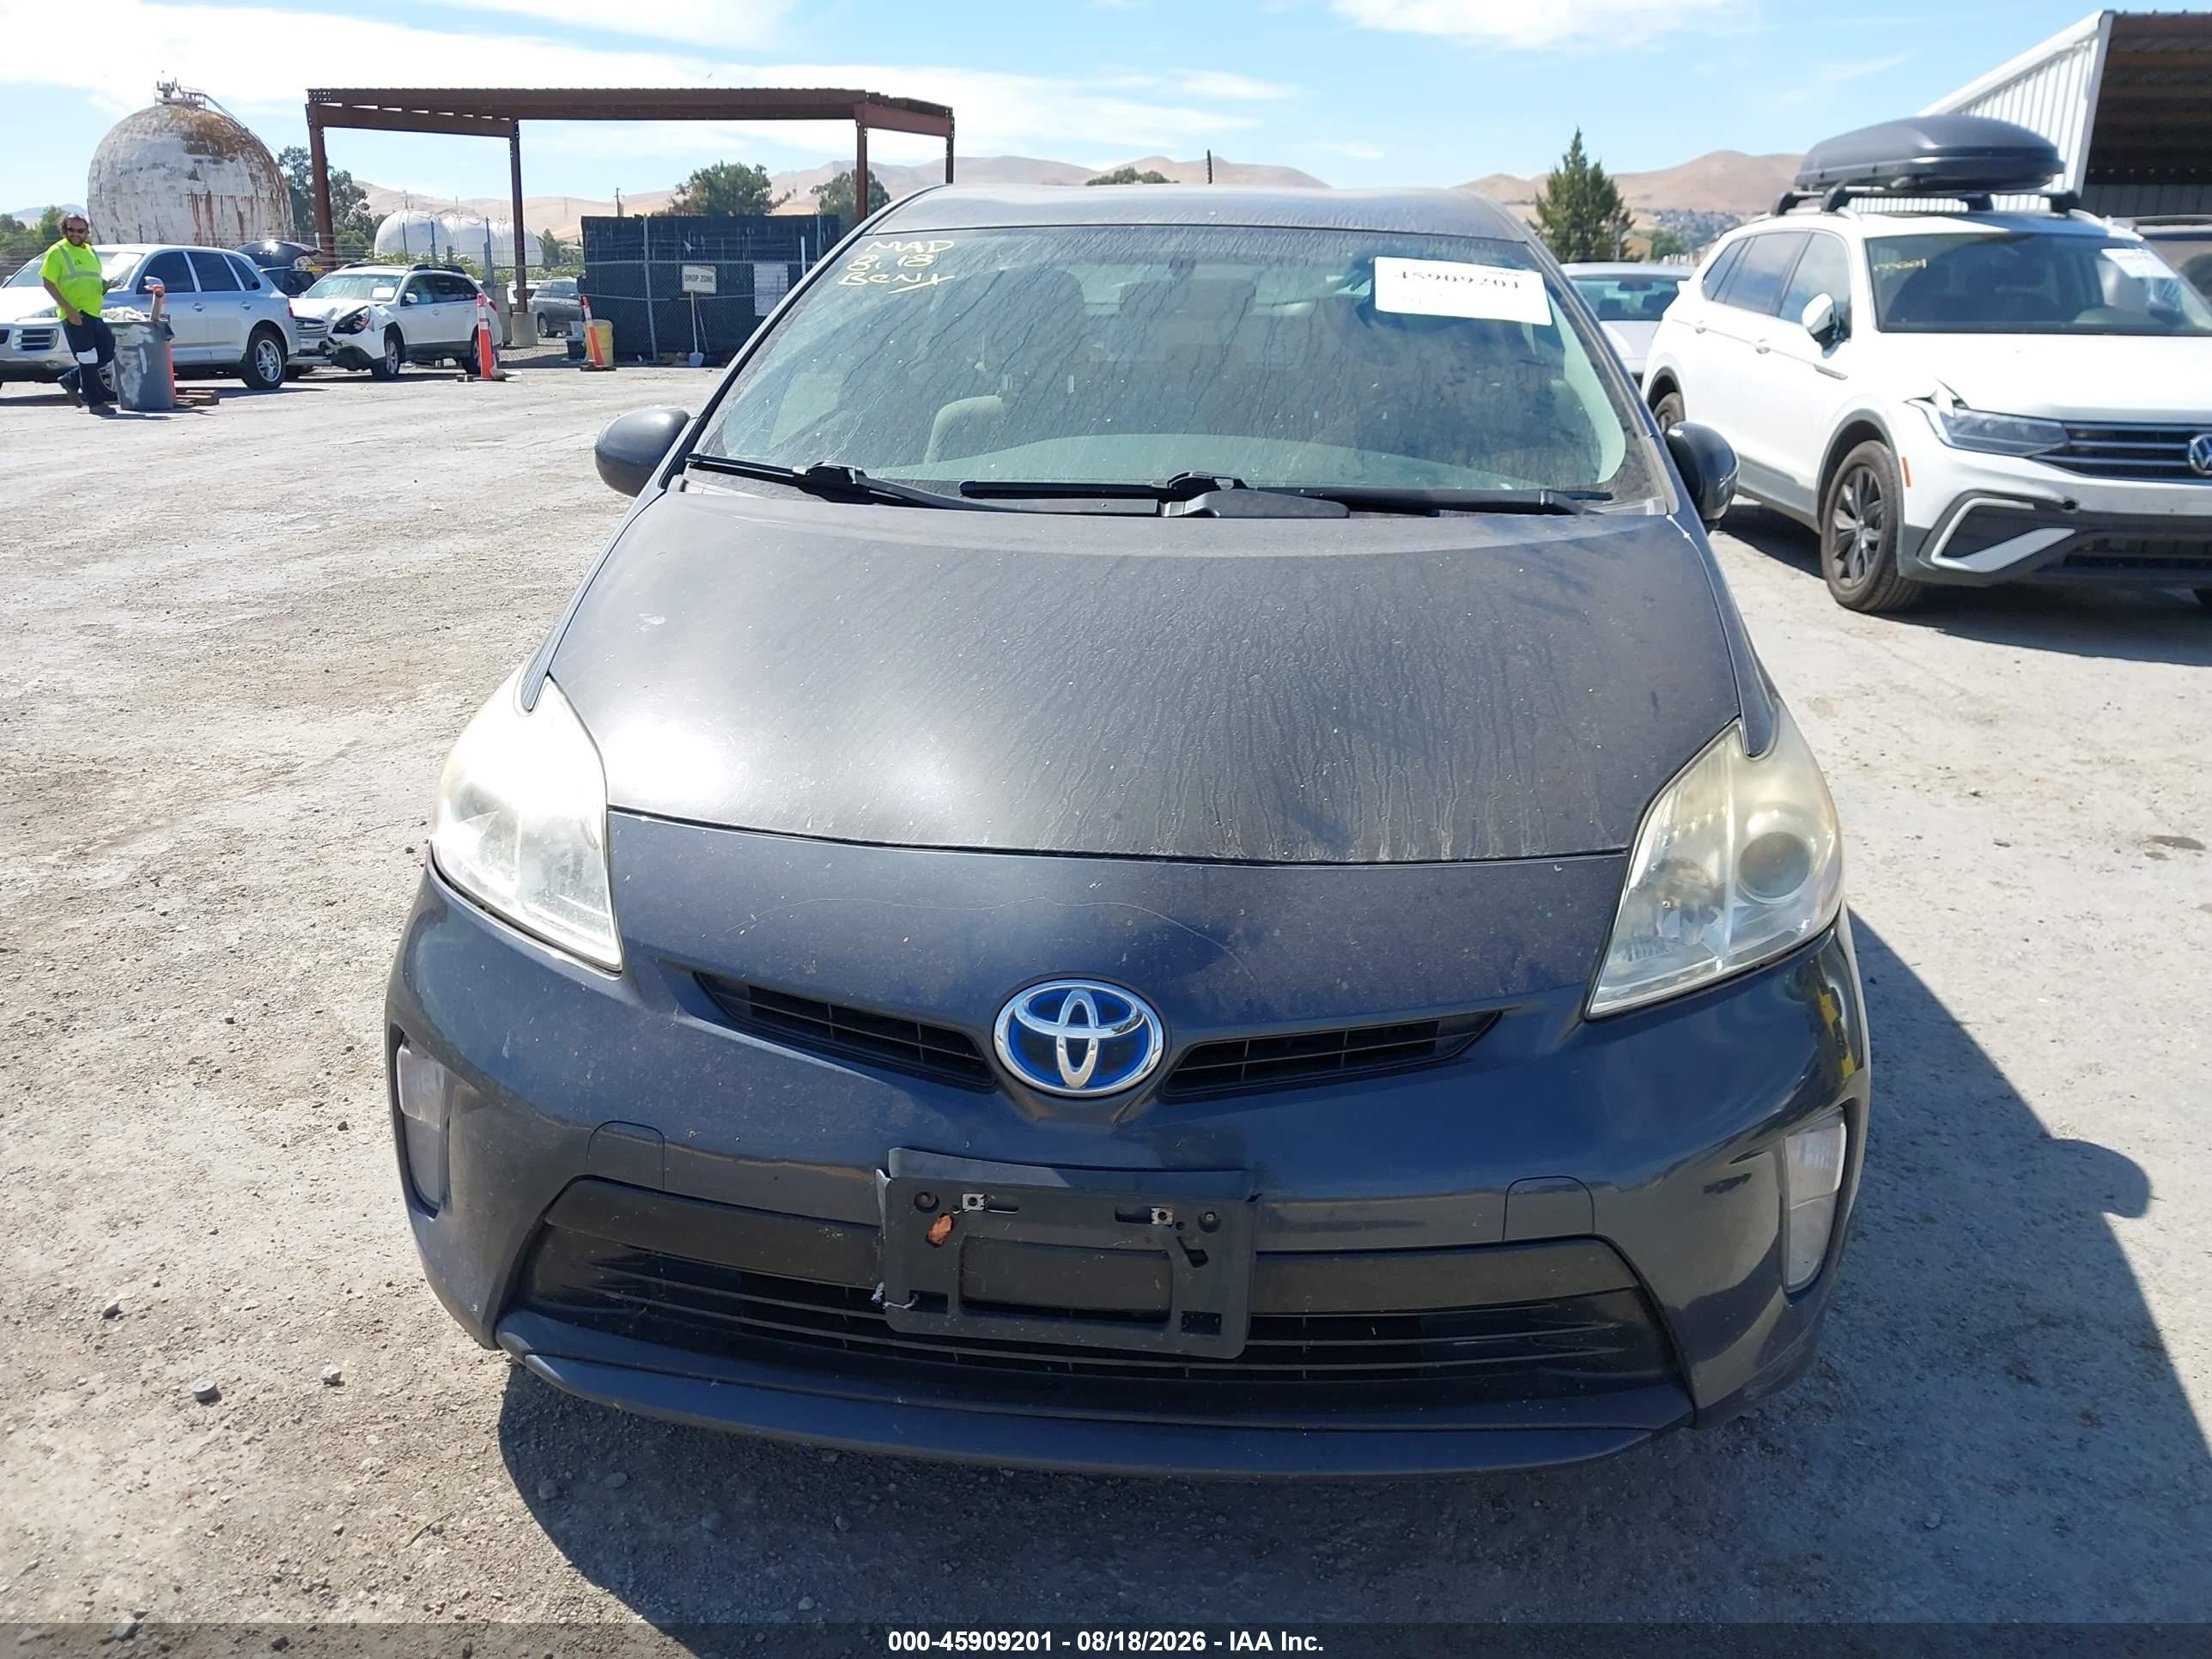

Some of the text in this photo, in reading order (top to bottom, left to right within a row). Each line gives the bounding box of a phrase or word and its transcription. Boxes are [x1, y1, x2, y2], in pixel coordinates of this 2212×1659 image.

[865, 240, 955, 254] MAD
[684, 274, 714, 283] DROP ZONE
